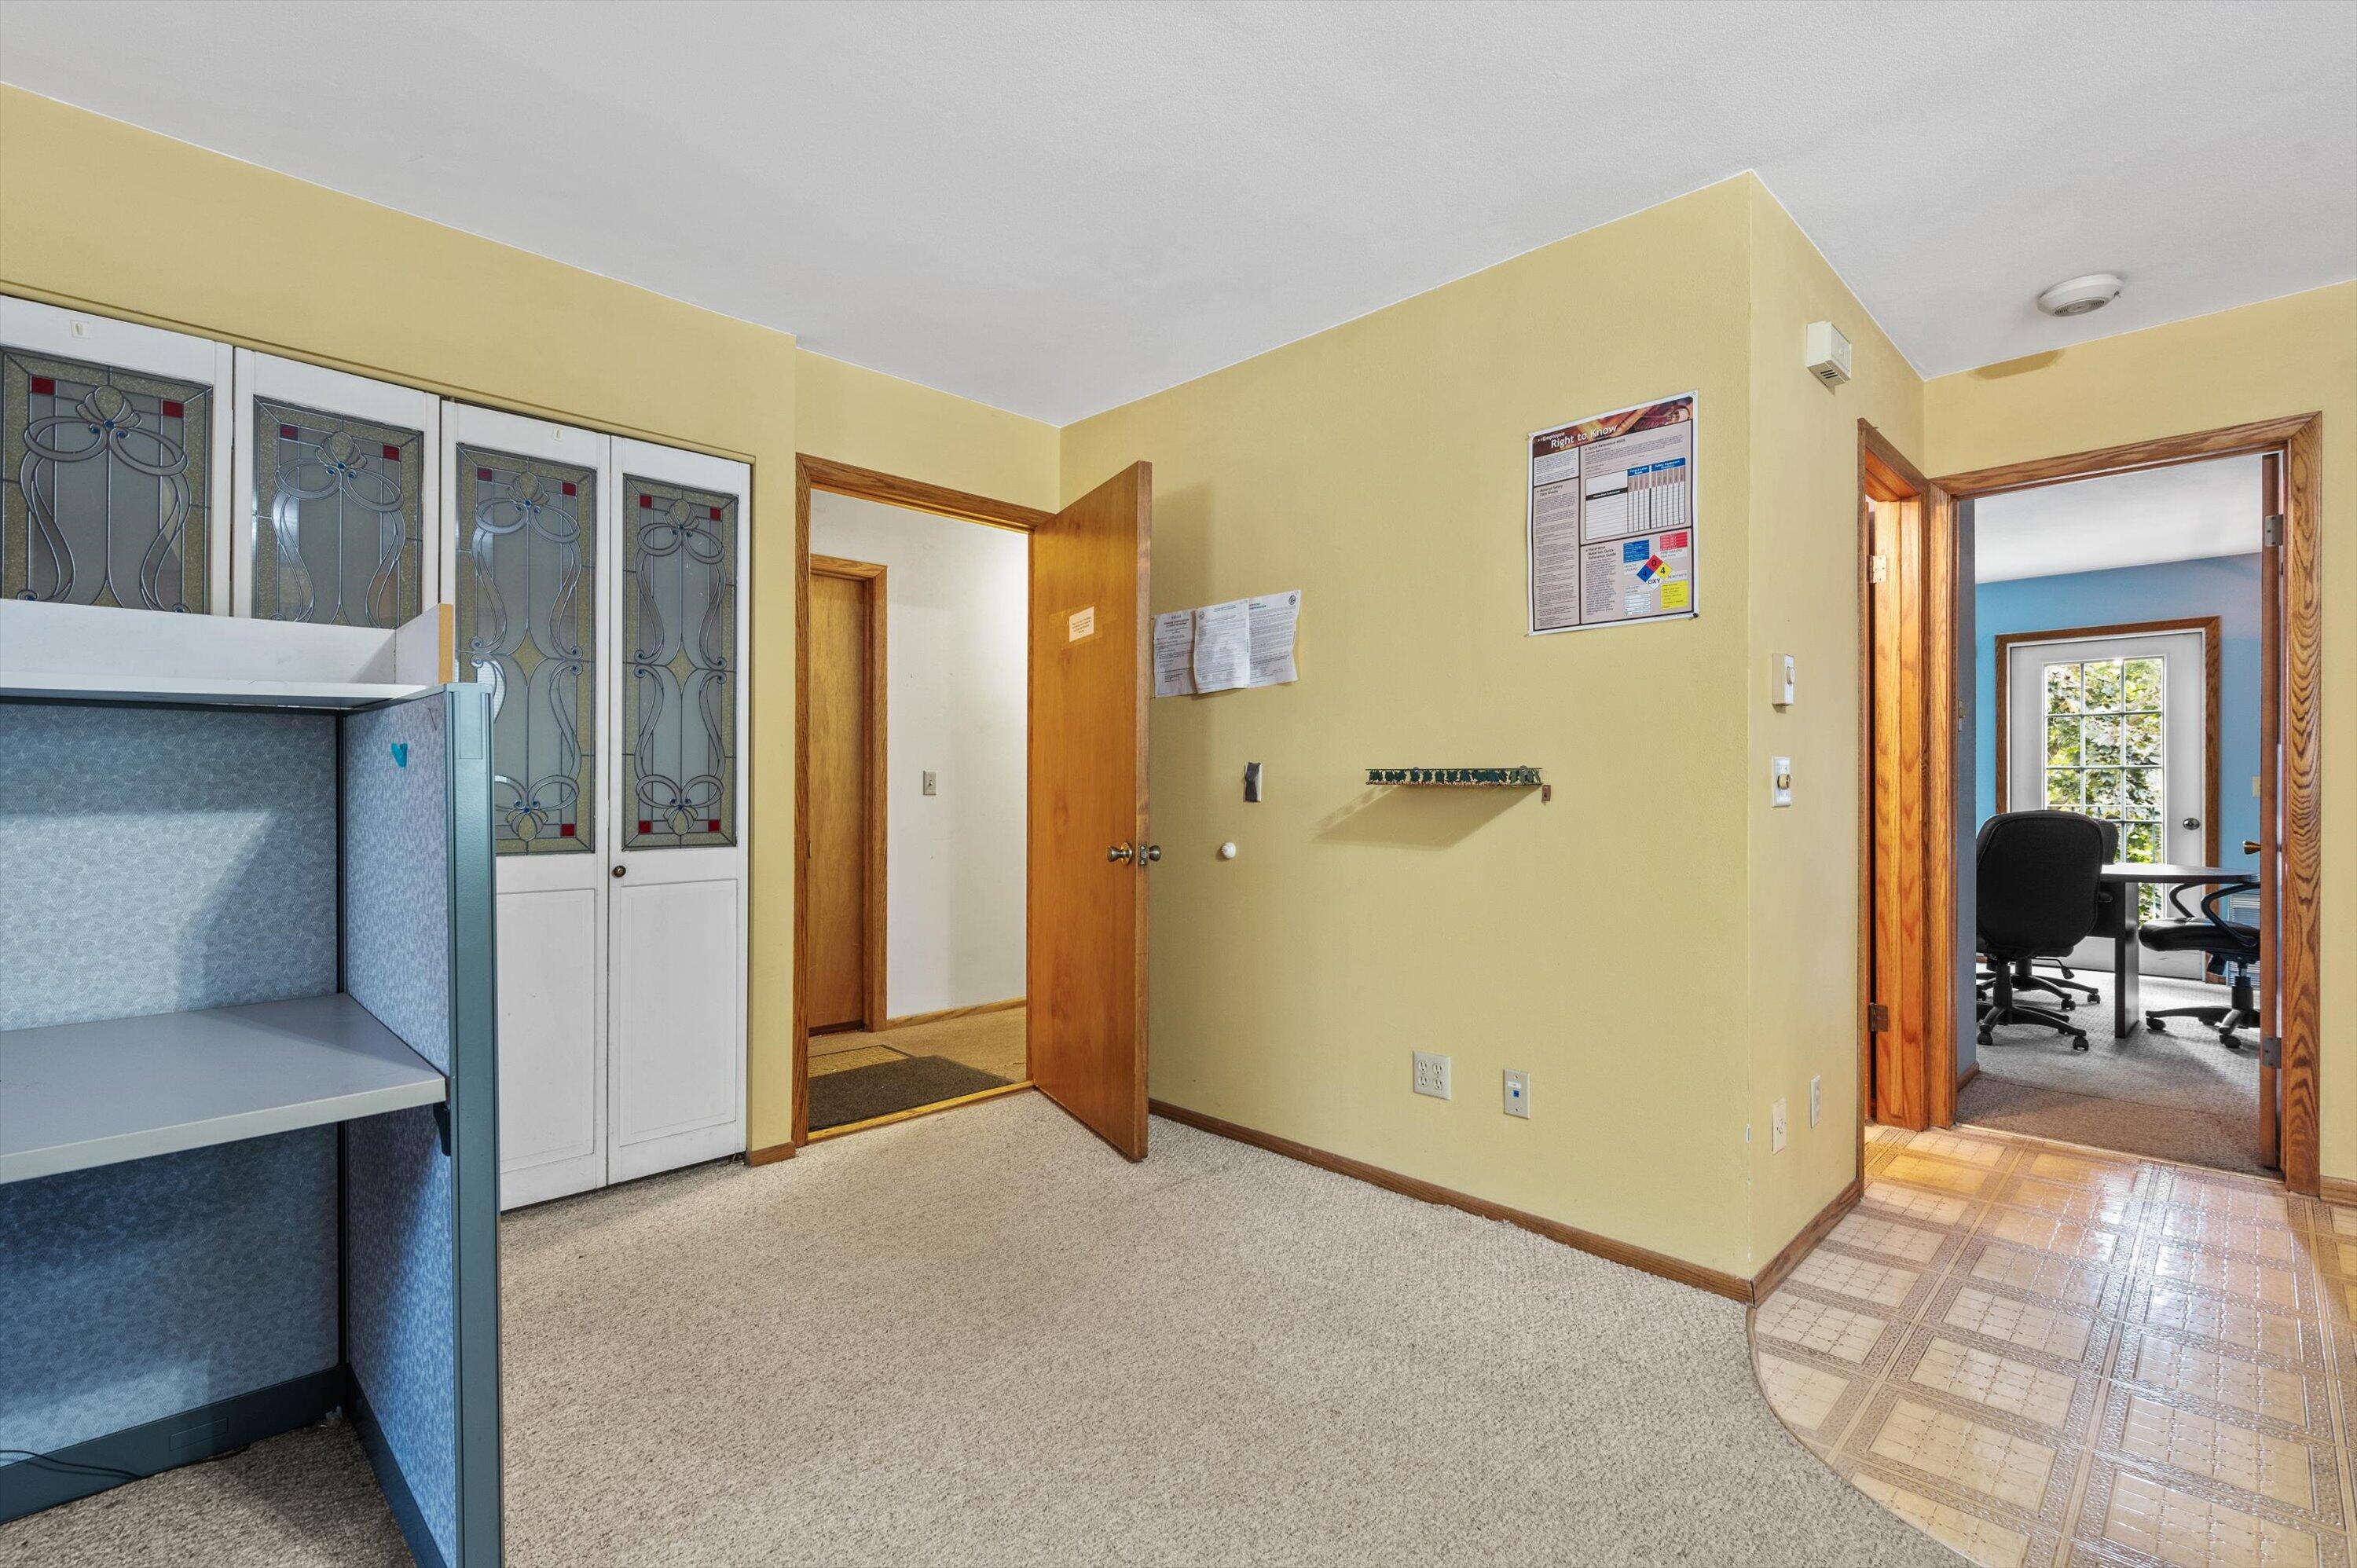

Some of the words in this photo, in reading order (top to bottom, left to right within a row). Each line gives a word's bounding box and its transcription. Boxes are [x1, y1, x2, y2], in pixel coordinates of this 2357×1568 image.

[1542, 432, 1565, 441] Employee
[1551, 435, 1574, 449] Right
[1577, 433, 1587, 441] to
[1590, 425, 1618, 438] Know
